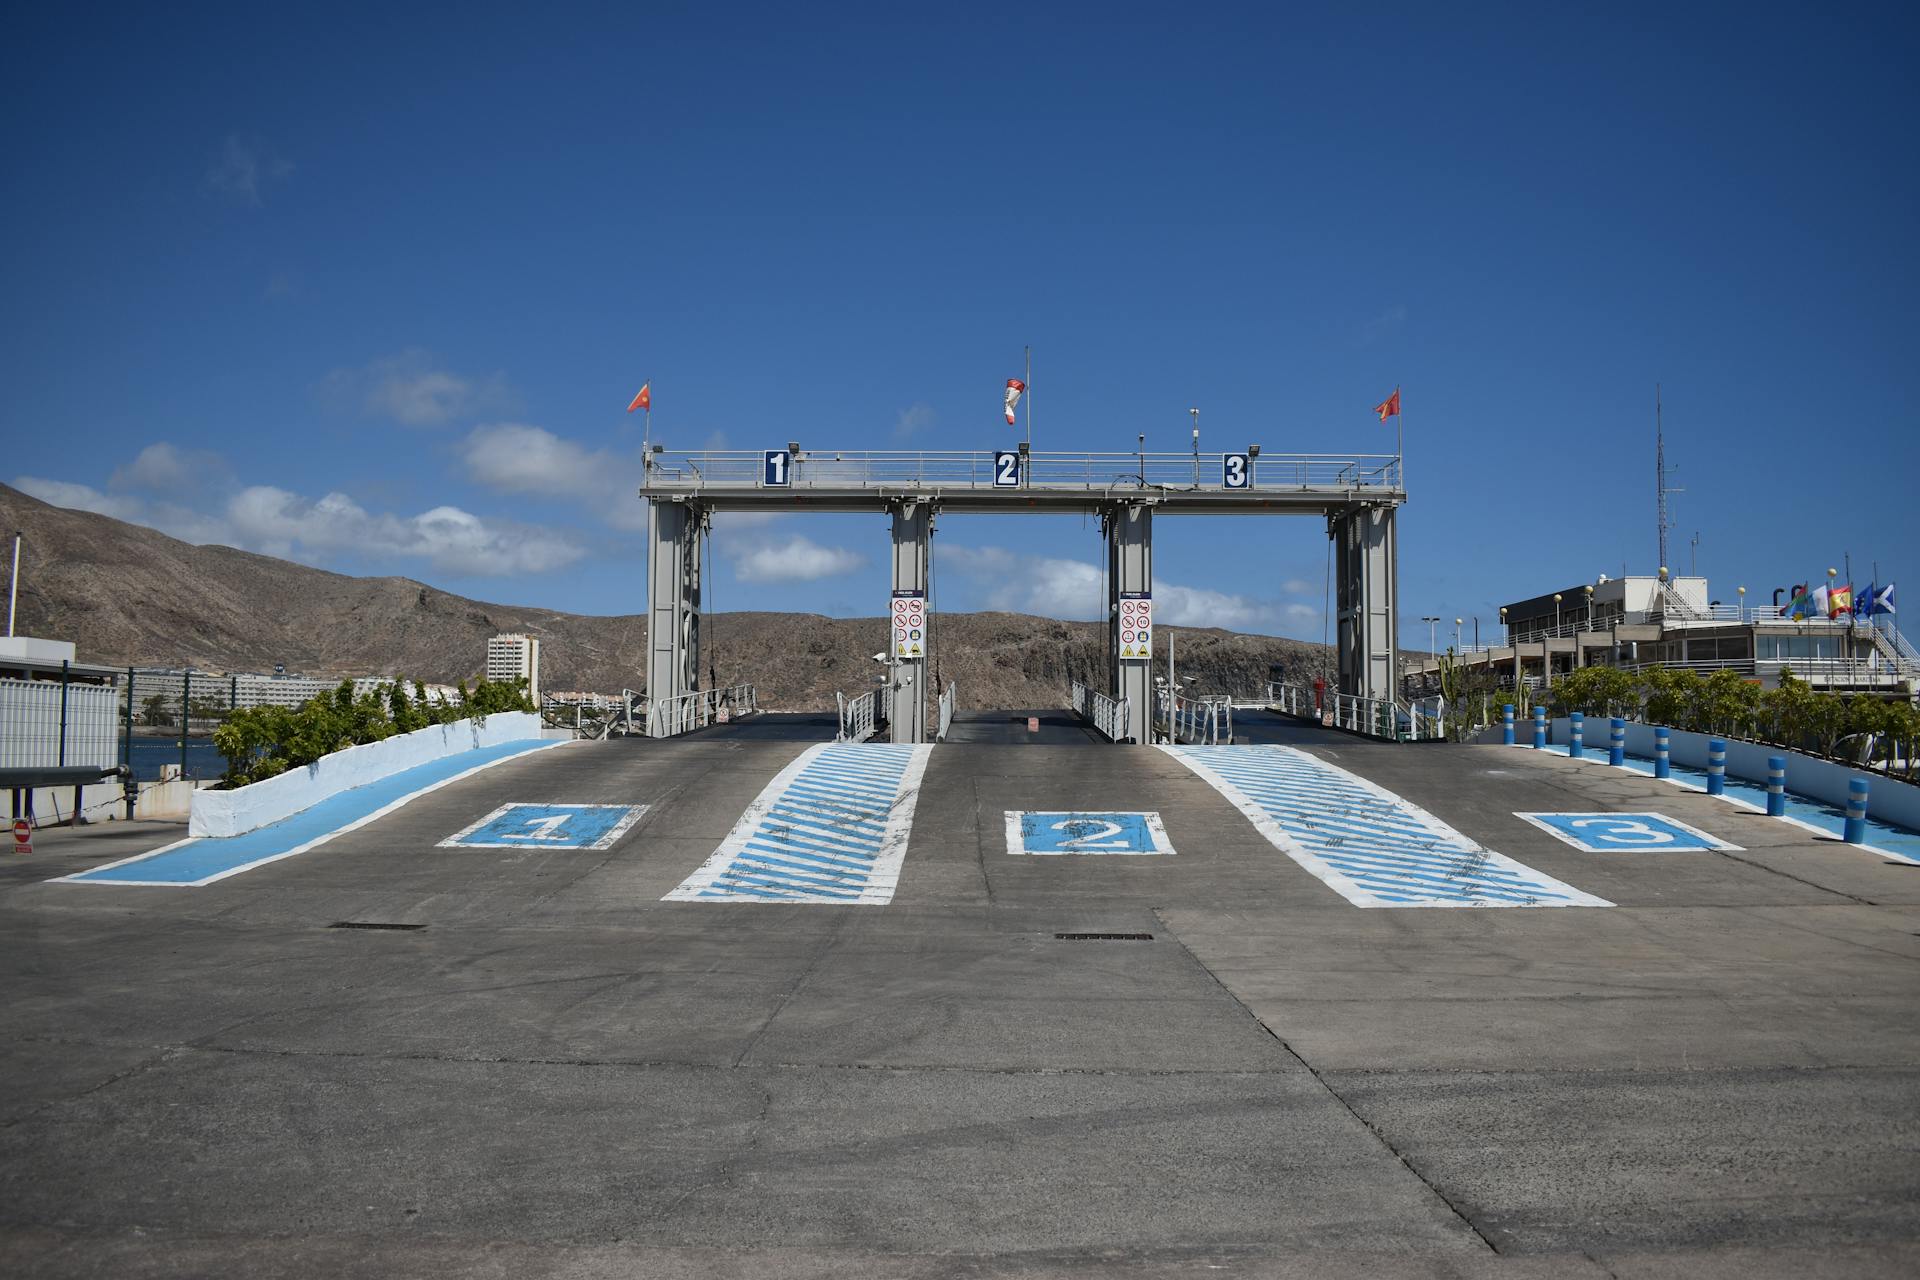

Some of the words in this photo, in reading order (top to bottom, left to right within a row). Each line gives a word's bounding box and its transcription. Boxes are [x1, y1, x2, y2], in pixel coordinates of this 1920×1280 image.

[770, 453, 784, 483] 1
[998, 454, 1017, 484] 2
[1226, 455, 1245, 487] 3
[501, 814, 573, 841] 1
[1051, 819, 1130, 848] 2
[1572, 819, 1675, 844] 3
